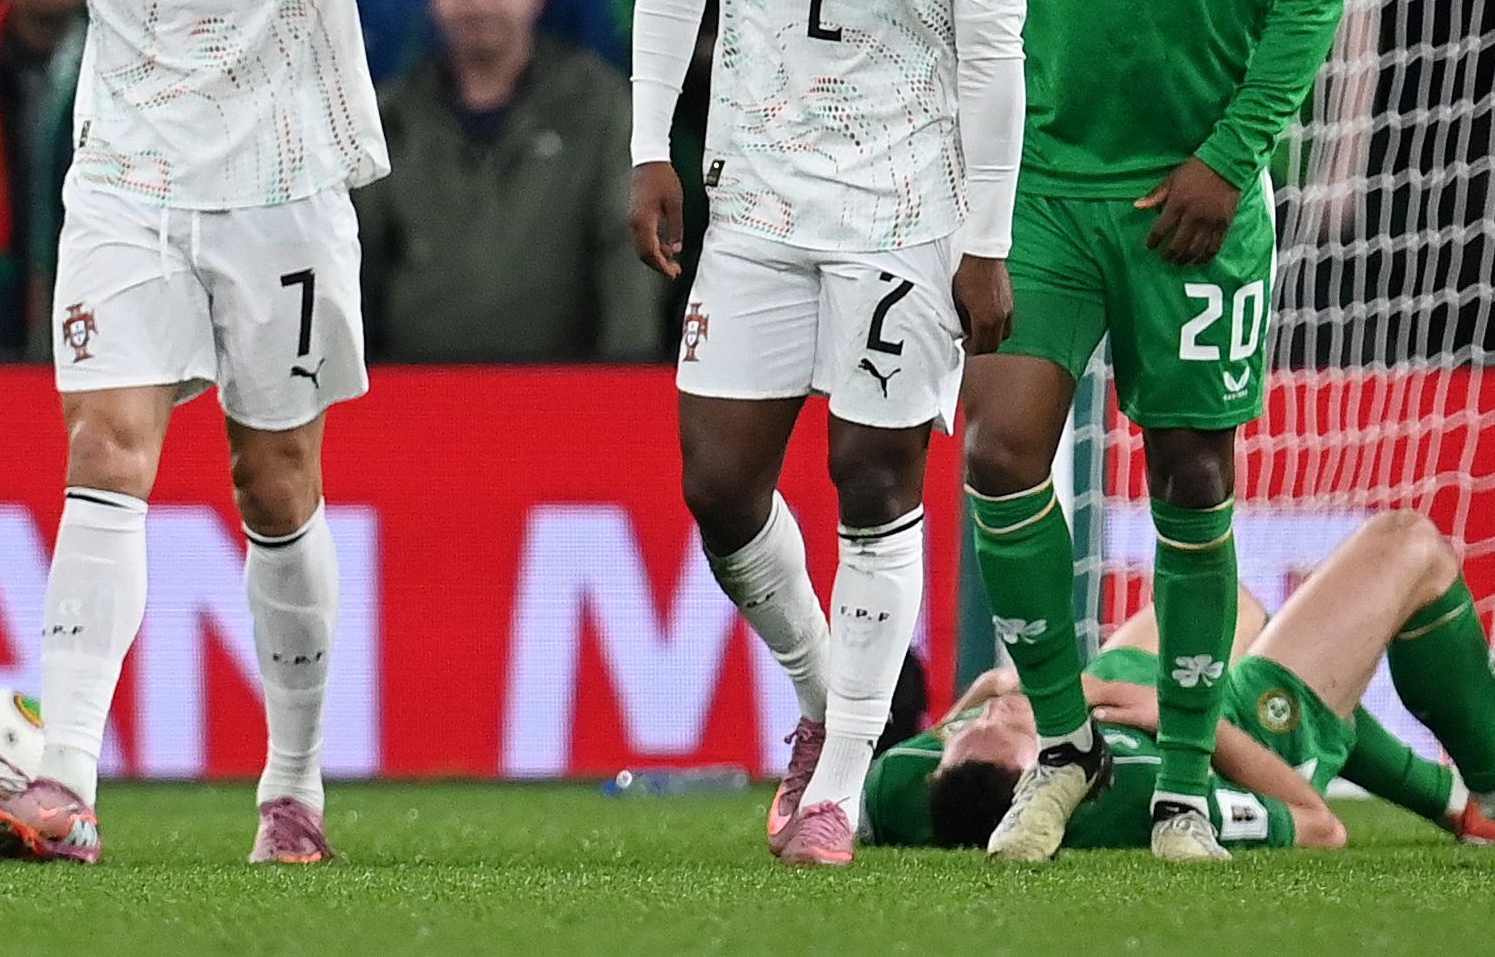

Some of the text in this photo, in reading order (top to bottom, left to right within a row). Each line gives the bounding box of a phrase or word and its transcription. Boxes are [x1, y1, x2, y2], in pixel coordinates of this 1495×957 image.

[280, 267, 315, 357] 7
[866, 272, 915, 355] 2
[1179, 279, 1264, 361] 20
